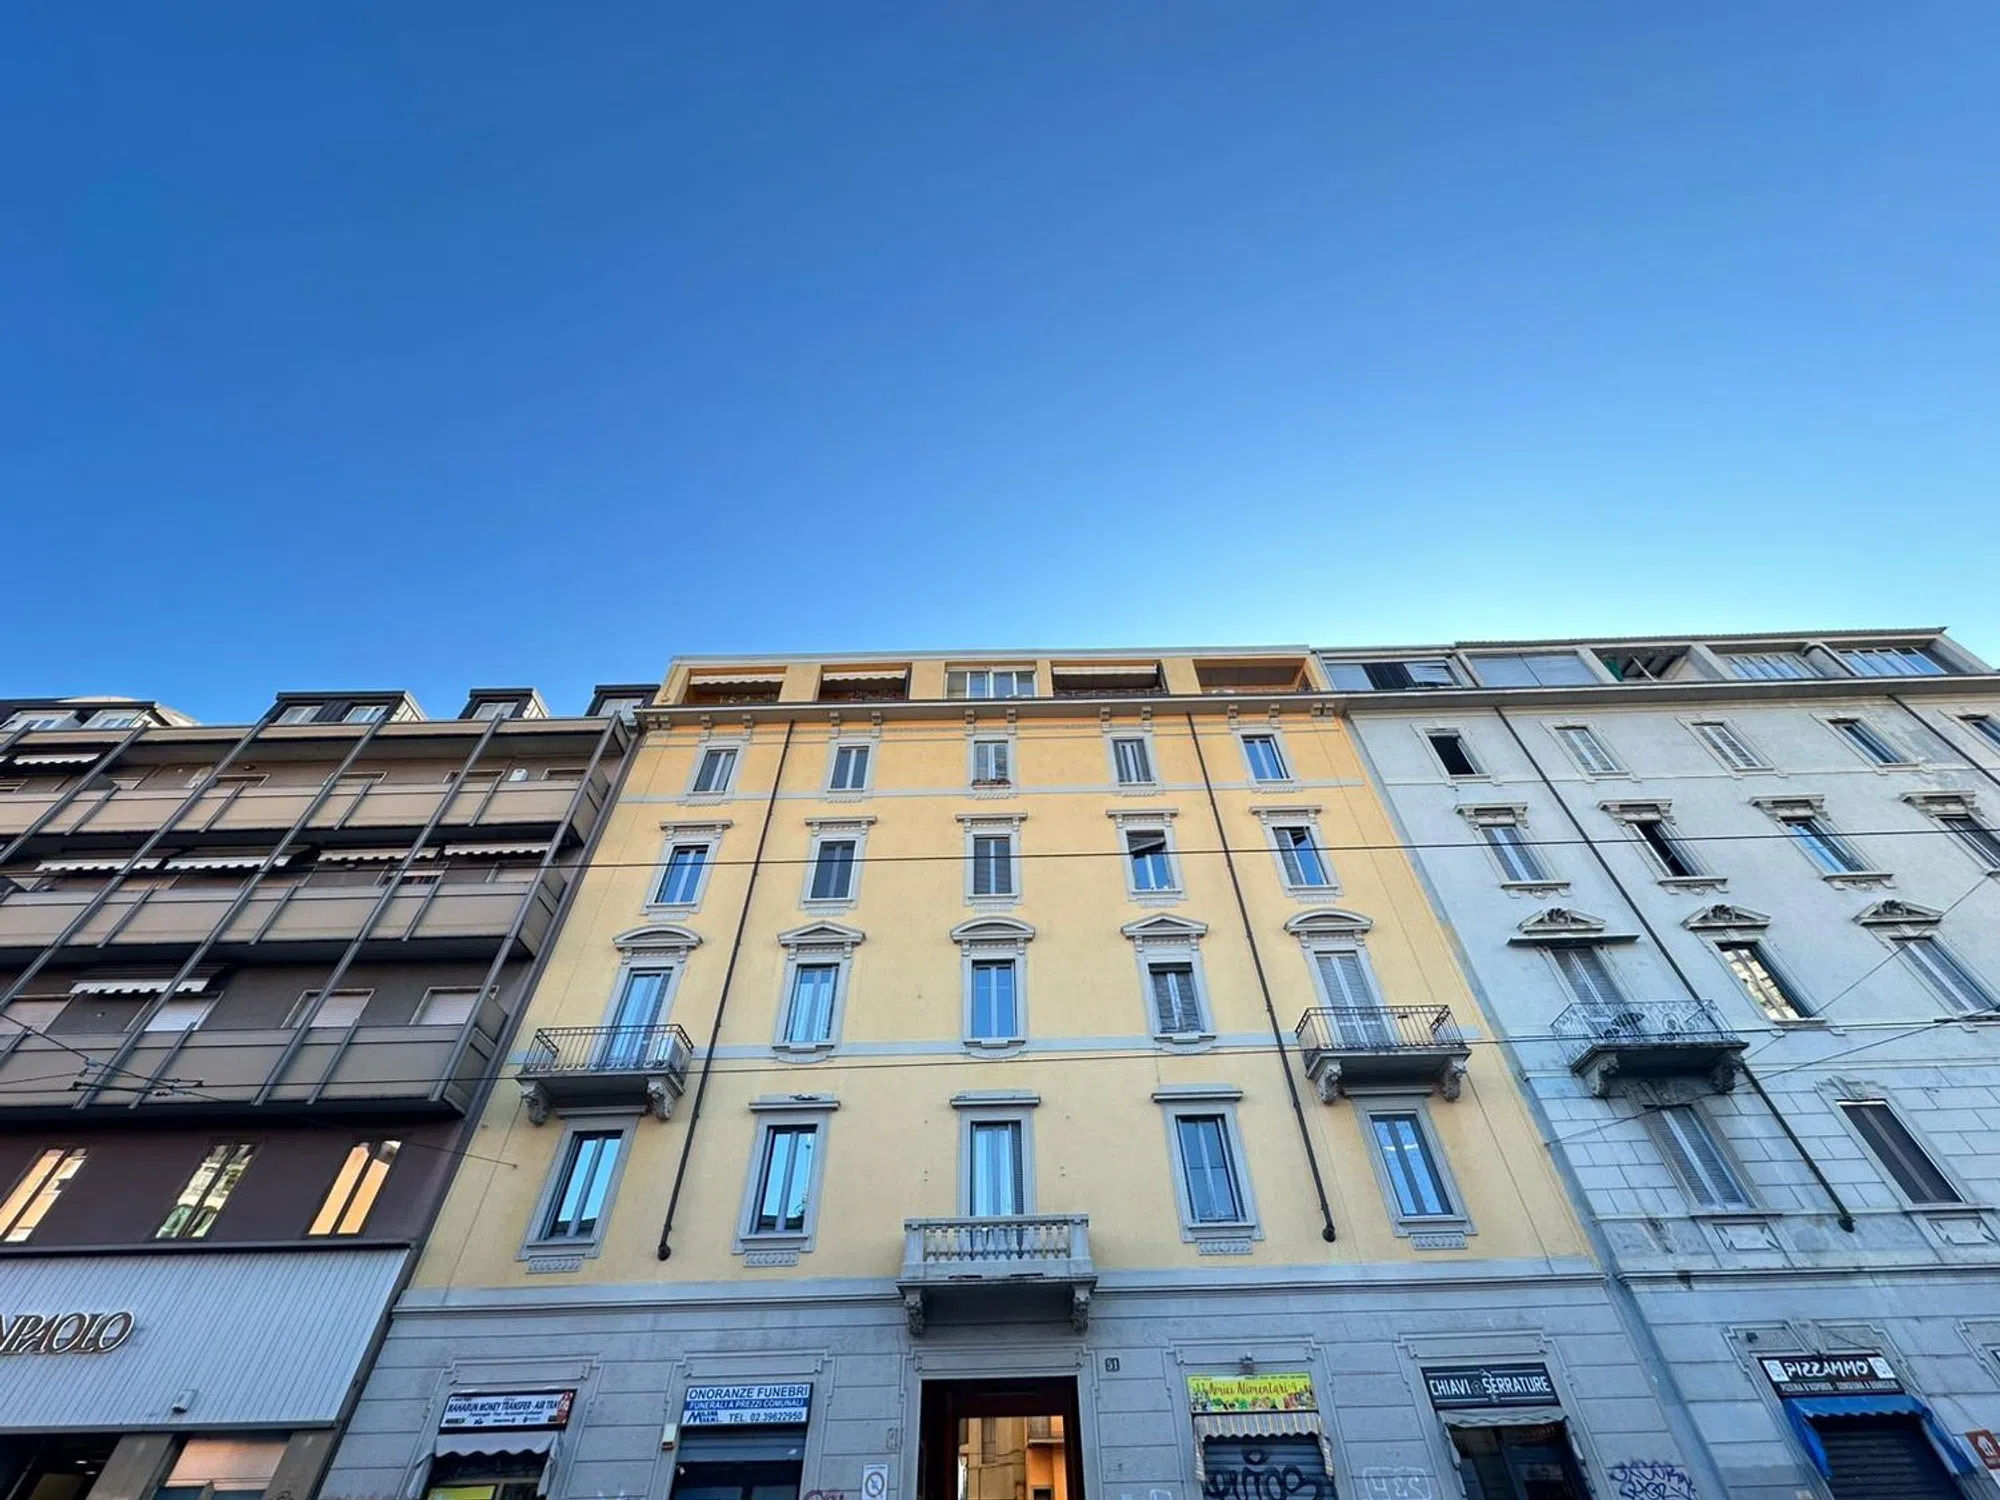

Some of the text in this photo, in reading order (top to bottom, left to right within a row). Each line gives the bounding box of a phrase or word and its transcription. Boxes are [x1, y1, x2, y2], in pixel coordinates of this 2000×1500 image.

[1429, 1376, 1552, 1396] CHIAVI SERRATURE
[689, 1386, 808, 1400] ONORANZE FUNEBRI
[478, 1402, 502, 1411] MONEY
[501, 1401, 532, 1411] TRANSFER
[689, 1402, 728, 1410] FUNERALI
[735, 1400, 762, 1409] PREZZI
[763, 1399, 804, 1408] COMUNALI
